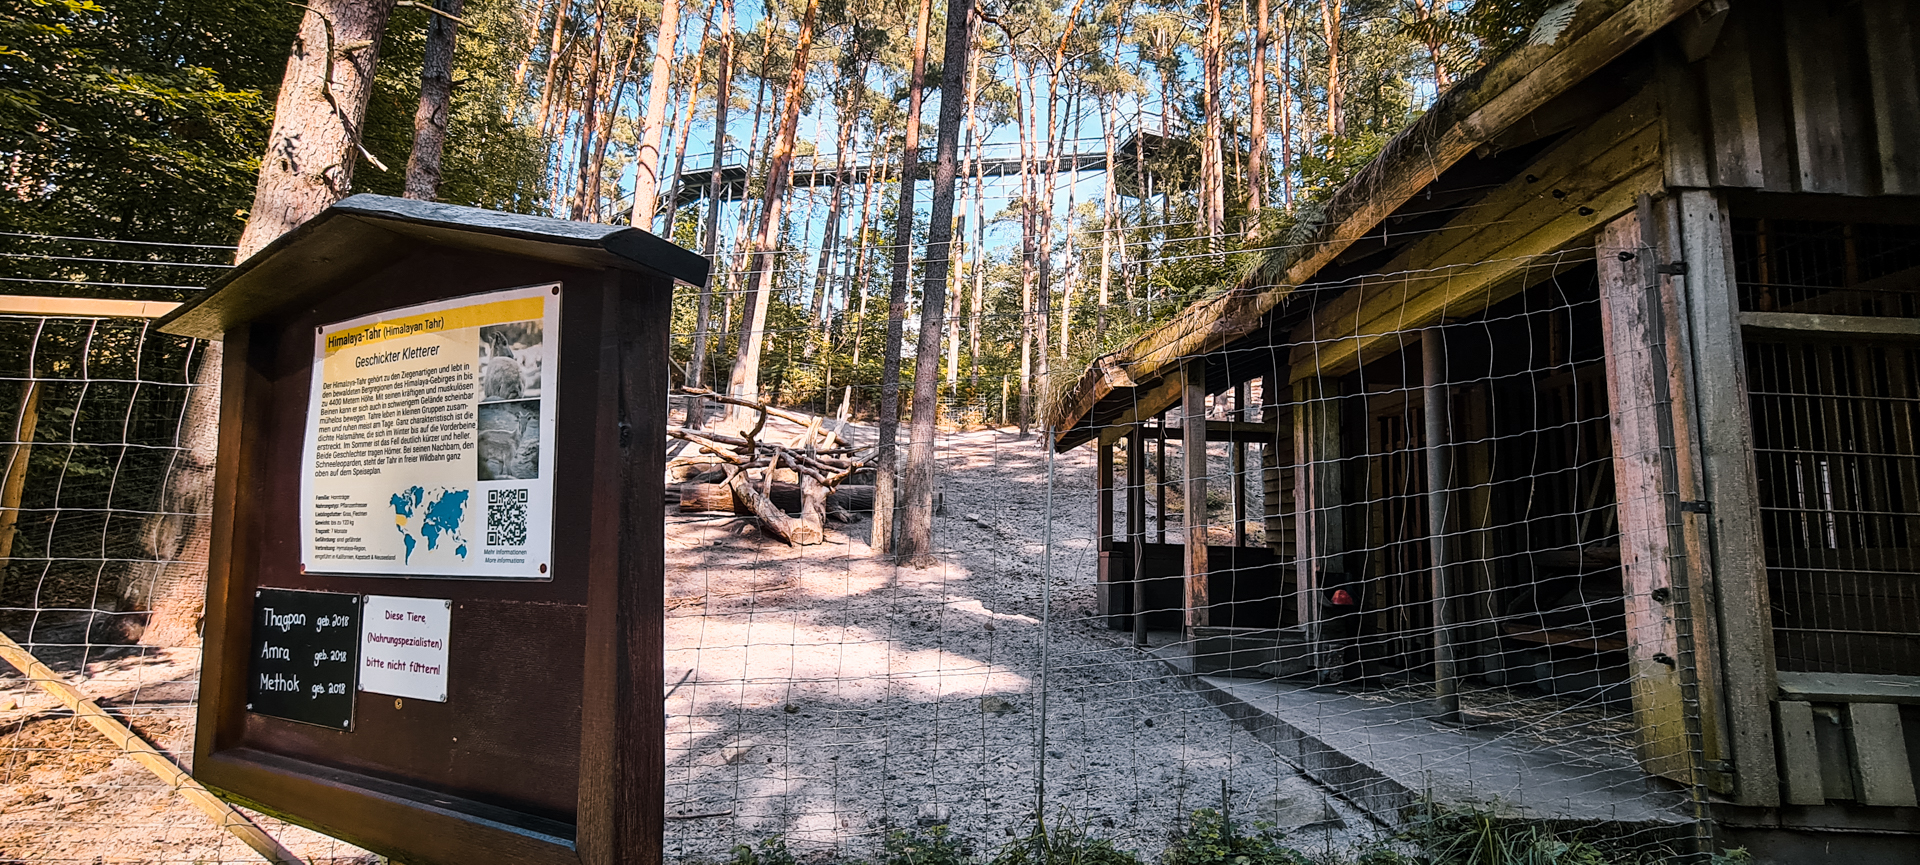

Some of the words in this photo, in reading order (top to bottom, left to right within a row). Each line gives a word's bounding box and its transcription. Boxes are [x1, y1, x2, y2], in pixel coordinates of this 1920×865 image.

[328, 327, 381, 348] Himalaya-Tahr
[384, 322, 423, 339] (Himalayan
[425, 317, 444, 330] Tahr)
[356, 351, 400, 368] Geschickter
[402, 345, 440, 360] Kletterer
[333, 378, 366, 389] Himalaya-Tahr
[368, 375, 383, 385] gehört
[401, 368, 437, 379] Ziegenartigen
[439, 365, 449, 373] und
[333, 388, 360, 397] bewaldeten
[362, 383, 393, 394] Bergregionen
[404, 375, 455, 387] Himalaya-Gebirges
[464, 372, 473, 380] bis
[402, 388, 425, 397] kräftigen
[426, 386, 436, 394] und
[438, 383, 473, 392] muskulösen
[339, 406, 351, 414] kann
[359, 404, 368, 412] sich
[388, 398, 419, 408] schwierigem
[421, 395, 443, 404] Gelände
[445, 392, 474, 402] scheinbar
[320, 416, 342, 424] mühelos
[382, 410, 395, 418] leben
[402, 407, 420, 415] kleinen
[422, 406, 445, 414] Gruppen
[447, 403, 468, 411] zusam-
[396, 418, 409, 426] Ganz
[410, 414, 454, 424] charakteristisch
[464, 411, 473, 419] die
[375, 429, 385, 437] sich
[394, 427, 409, 435] Winter
[420, 425, 429, 433] auf
[430, 424, 439, 432] die
[440, 422, 475, 431] Vorderbeine
[401, 435, 421, 444] deutlich
[423, 434, 439, 442] kürzer
[333, 450, 366, 458] Geschlechter
[403, 445, 411, 453] Bei
[463, 441, 474, 449] den
[386, 456, 397, 464] Tahr
[419, 453, 445, 461] Wildbahn
[446, 453, 460, 462] ganz
[340, 468, 351, 476] dem
[264, 608, 306, 632] Thagpan
[316, 616, 330, 632] geb.
[332, 614, 349, 627] 2018
[385, 610, 403, 621] Diese
[407, 612, 426, 623] Tiere
[367, 632, 442, 650] (Nahrungspezialisten)
[261, 641, 290, 661] Amra
[314, 651, 328, 666] geb.
[331, 650, 347, 662] 2018
[366, 657, 384, 669] bitte
[387, 658, 406, 671] nicht
[410, 661, 440, 675] füttern!
[260, 673, 300, 692] Methok
[312, 684, 325, 699] geb.
[328, 683, 346, 695] 2018
